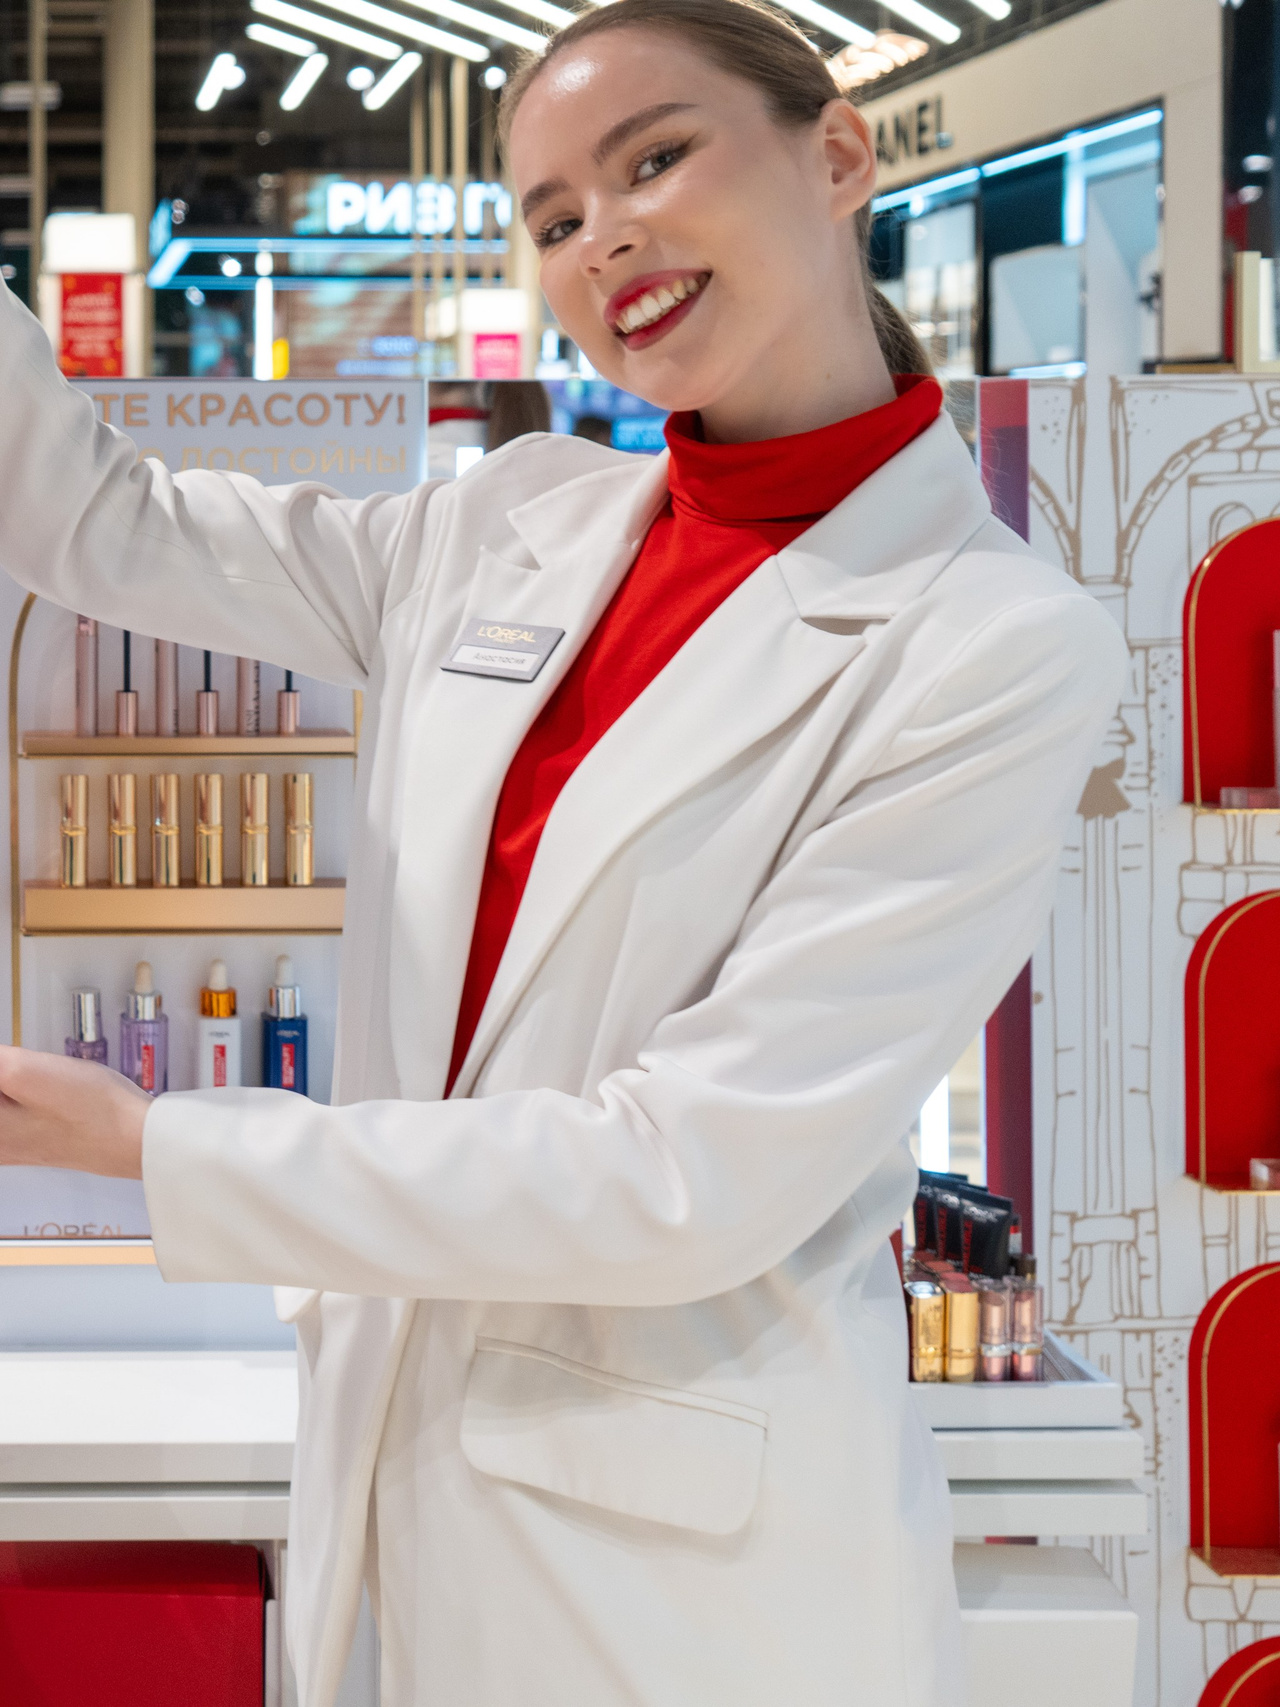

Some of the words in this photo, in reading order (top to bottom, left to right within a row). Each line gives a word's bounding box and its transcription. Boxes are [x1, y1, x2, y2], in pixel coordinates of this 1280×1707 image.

[326, 180, 456, 234] РИВ
[166, 393, 406, 427] КРАСОТУ!
[179, 440, 406, 475] ДОСТОЙНЫ
